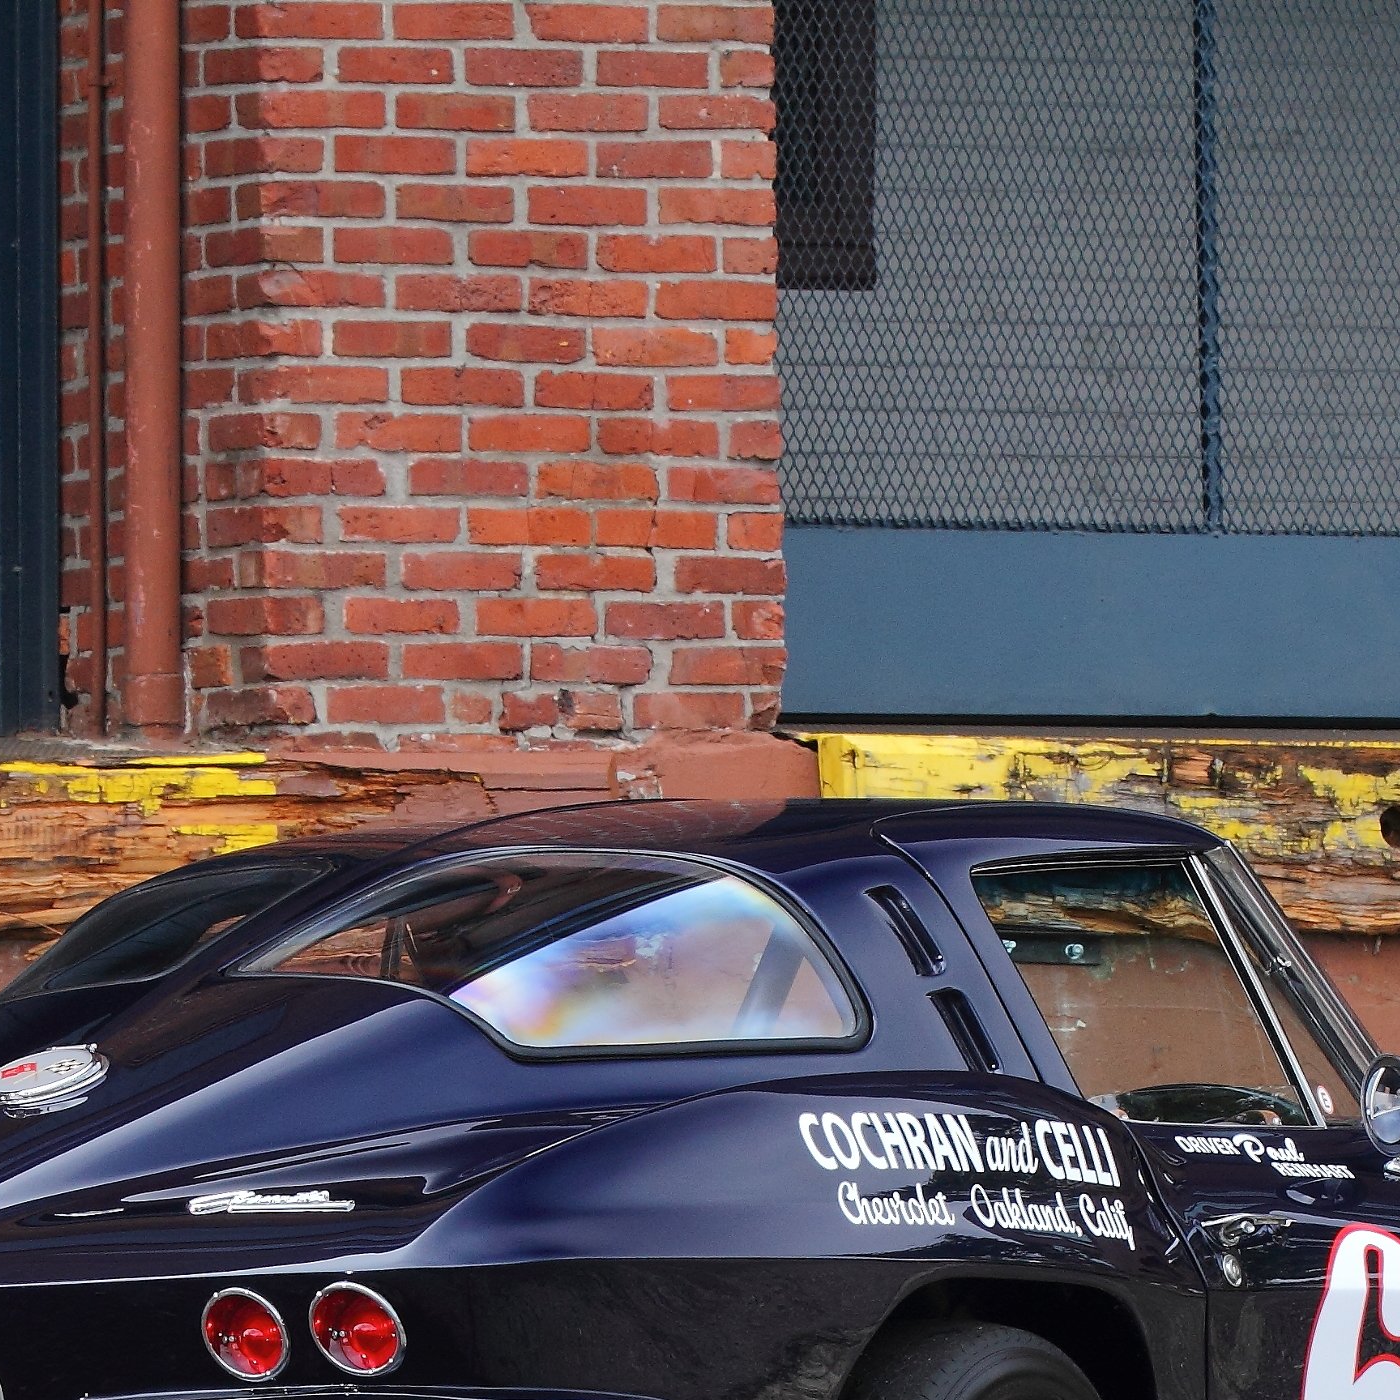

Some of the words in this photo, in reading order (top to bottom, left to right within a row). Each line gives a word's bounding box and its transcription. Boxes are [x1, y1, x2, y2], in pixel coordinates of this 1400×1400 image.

[798, 1111, 985, 1173] COCHRAN
[985, 1121, 1039, 1174] and
[1034, 1118, 1121, 1187] CELLI
[1174, 1135, 1241, 1155] DRIVER
[1232, 1133, 1305, 1163] Paul
[1271, 1162, 1356, 1179] REINHART
[837, 1180, 956, 1226] Chevrolet
[970, 1183, 1083, 1238] Oakland,
[1078, 1193, 1136, 1251] Calif
